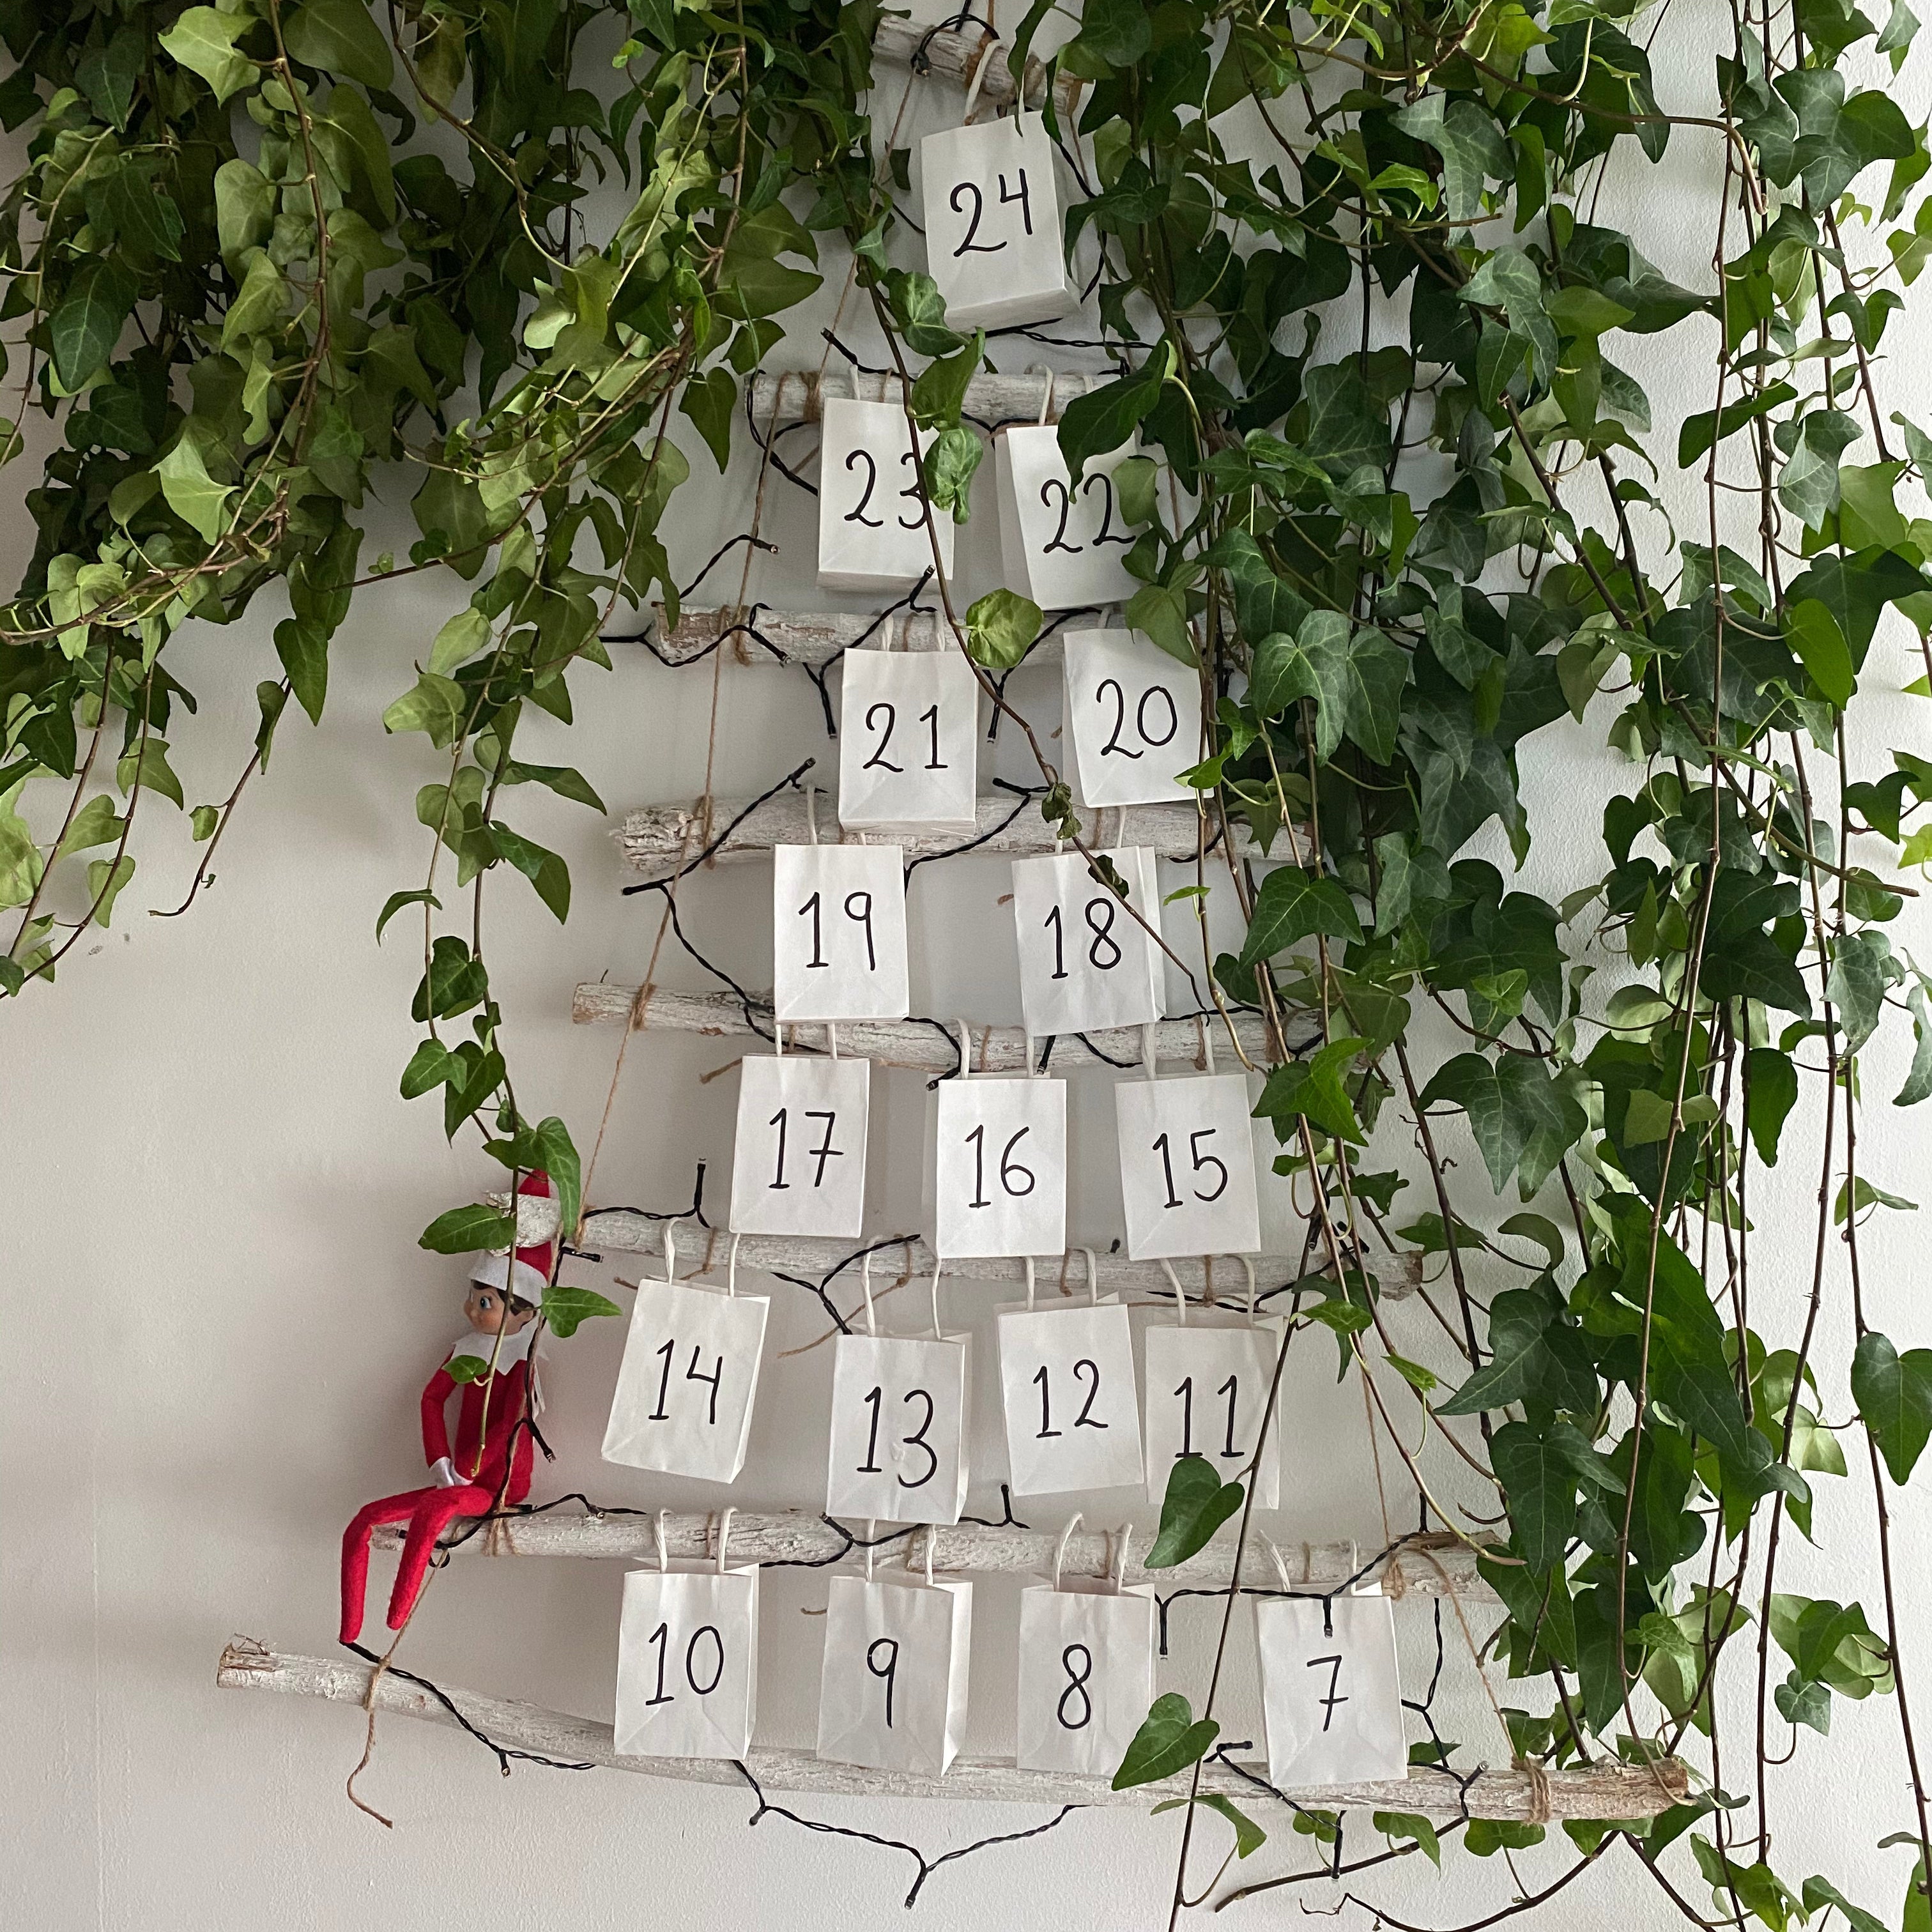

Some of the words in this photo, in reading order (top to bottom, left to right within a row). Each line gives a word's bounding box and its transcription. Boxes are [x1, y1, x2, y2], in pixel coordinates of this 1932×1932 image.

[950, 167, 1032, 257] 24
[844, 448, 928, 530] 23
[1041, 472, 1137, 555] 22
[863, 703, 948, 772] 21
[1096, 679, 1177, 758] 20
[799, 892, 875, 970] 19
[1045, 897, 1123, 979] 18
[769, 1108, 843, 1189] 17
[965, 1125, 1034, 1208] 16
[1153, 1129, 1227, 1208] 15
[648, 1339, 723, 1424] 14
[1033, 1360, 1109, 1438] 12
[1174, 1375, 1245, 1458] 11
[857, 1386, 937, 1488] 13
[646, 1623, 723, 1705] 10
[867, 1639, 898, 1728] 9
[1057, 1644, 1091, 1729] 8
[1307, 1655, 1349, 1731] 7
